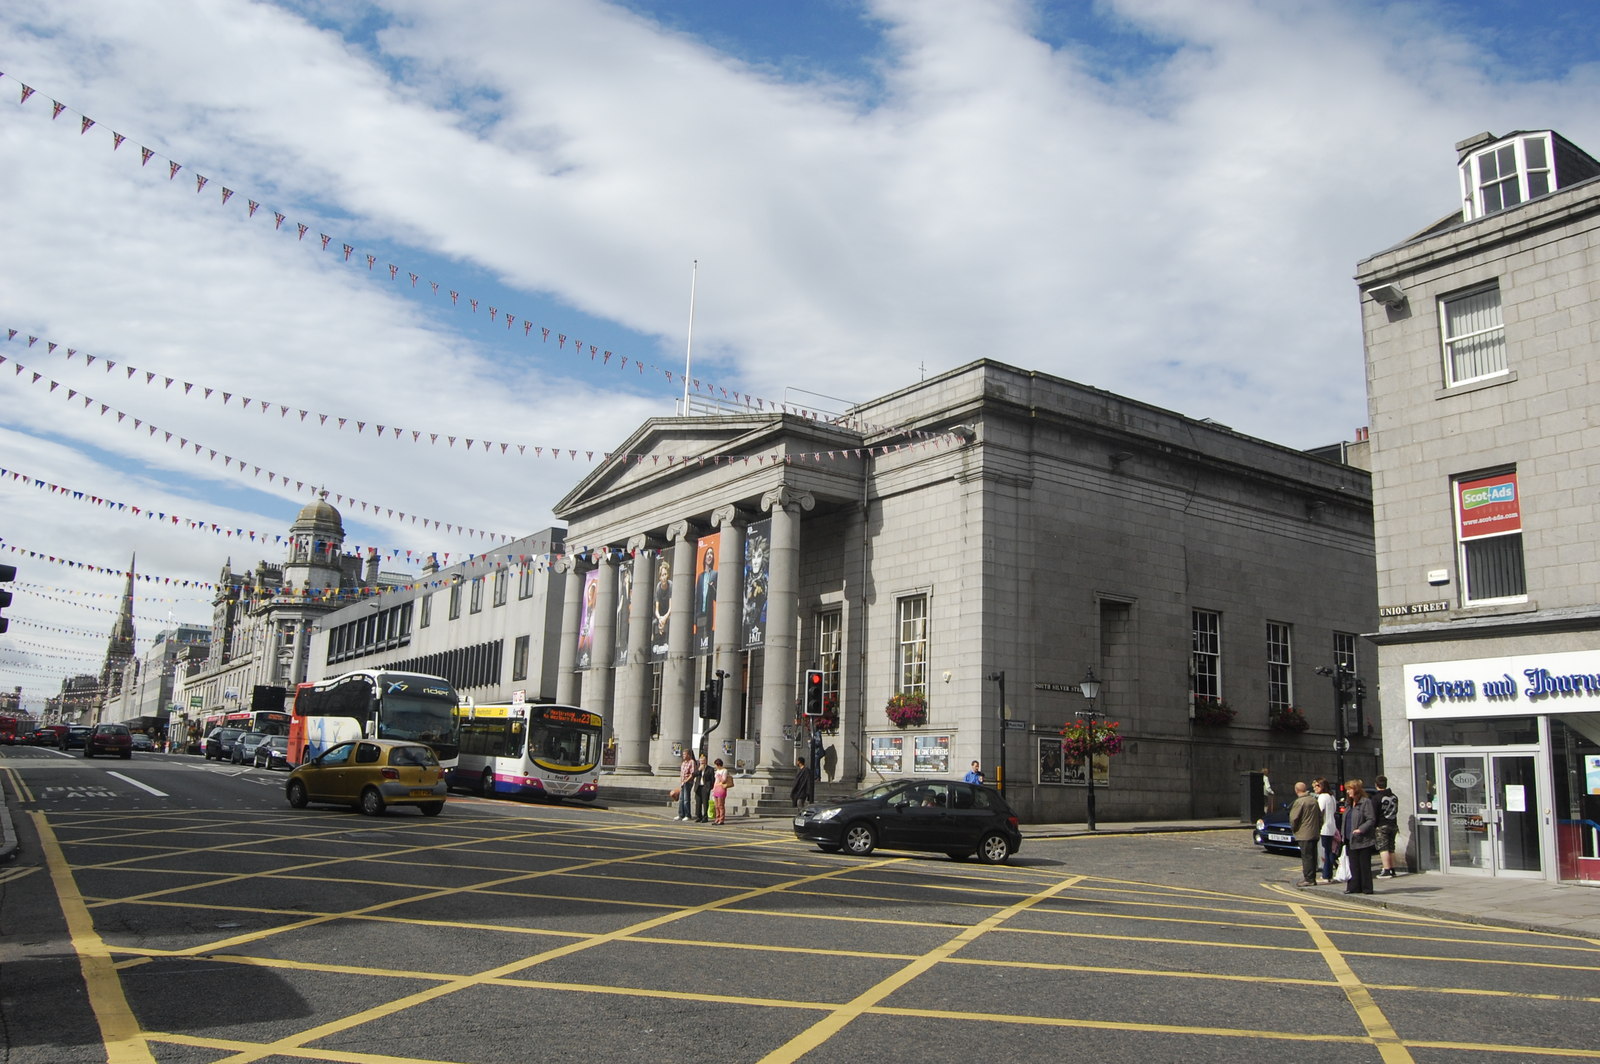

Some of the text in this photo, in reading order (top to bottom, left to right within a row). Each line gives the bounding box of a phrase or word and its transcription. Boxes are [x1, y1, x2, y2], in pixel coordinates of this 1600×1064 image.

[1464, 487, 1512, 504] Scot-Ads
[1462, 512, 1519, 526] www.scot-ads.com
[1380, 601, 1447, 616] UNION STREET
[423, 687, 450, 696] rider
[1413, 674, 1475, 704] Press
[1483, 673, 1517, 697] and
[581, 713, 590, 724] 23
[1454, 775, 1476, 785] shop
